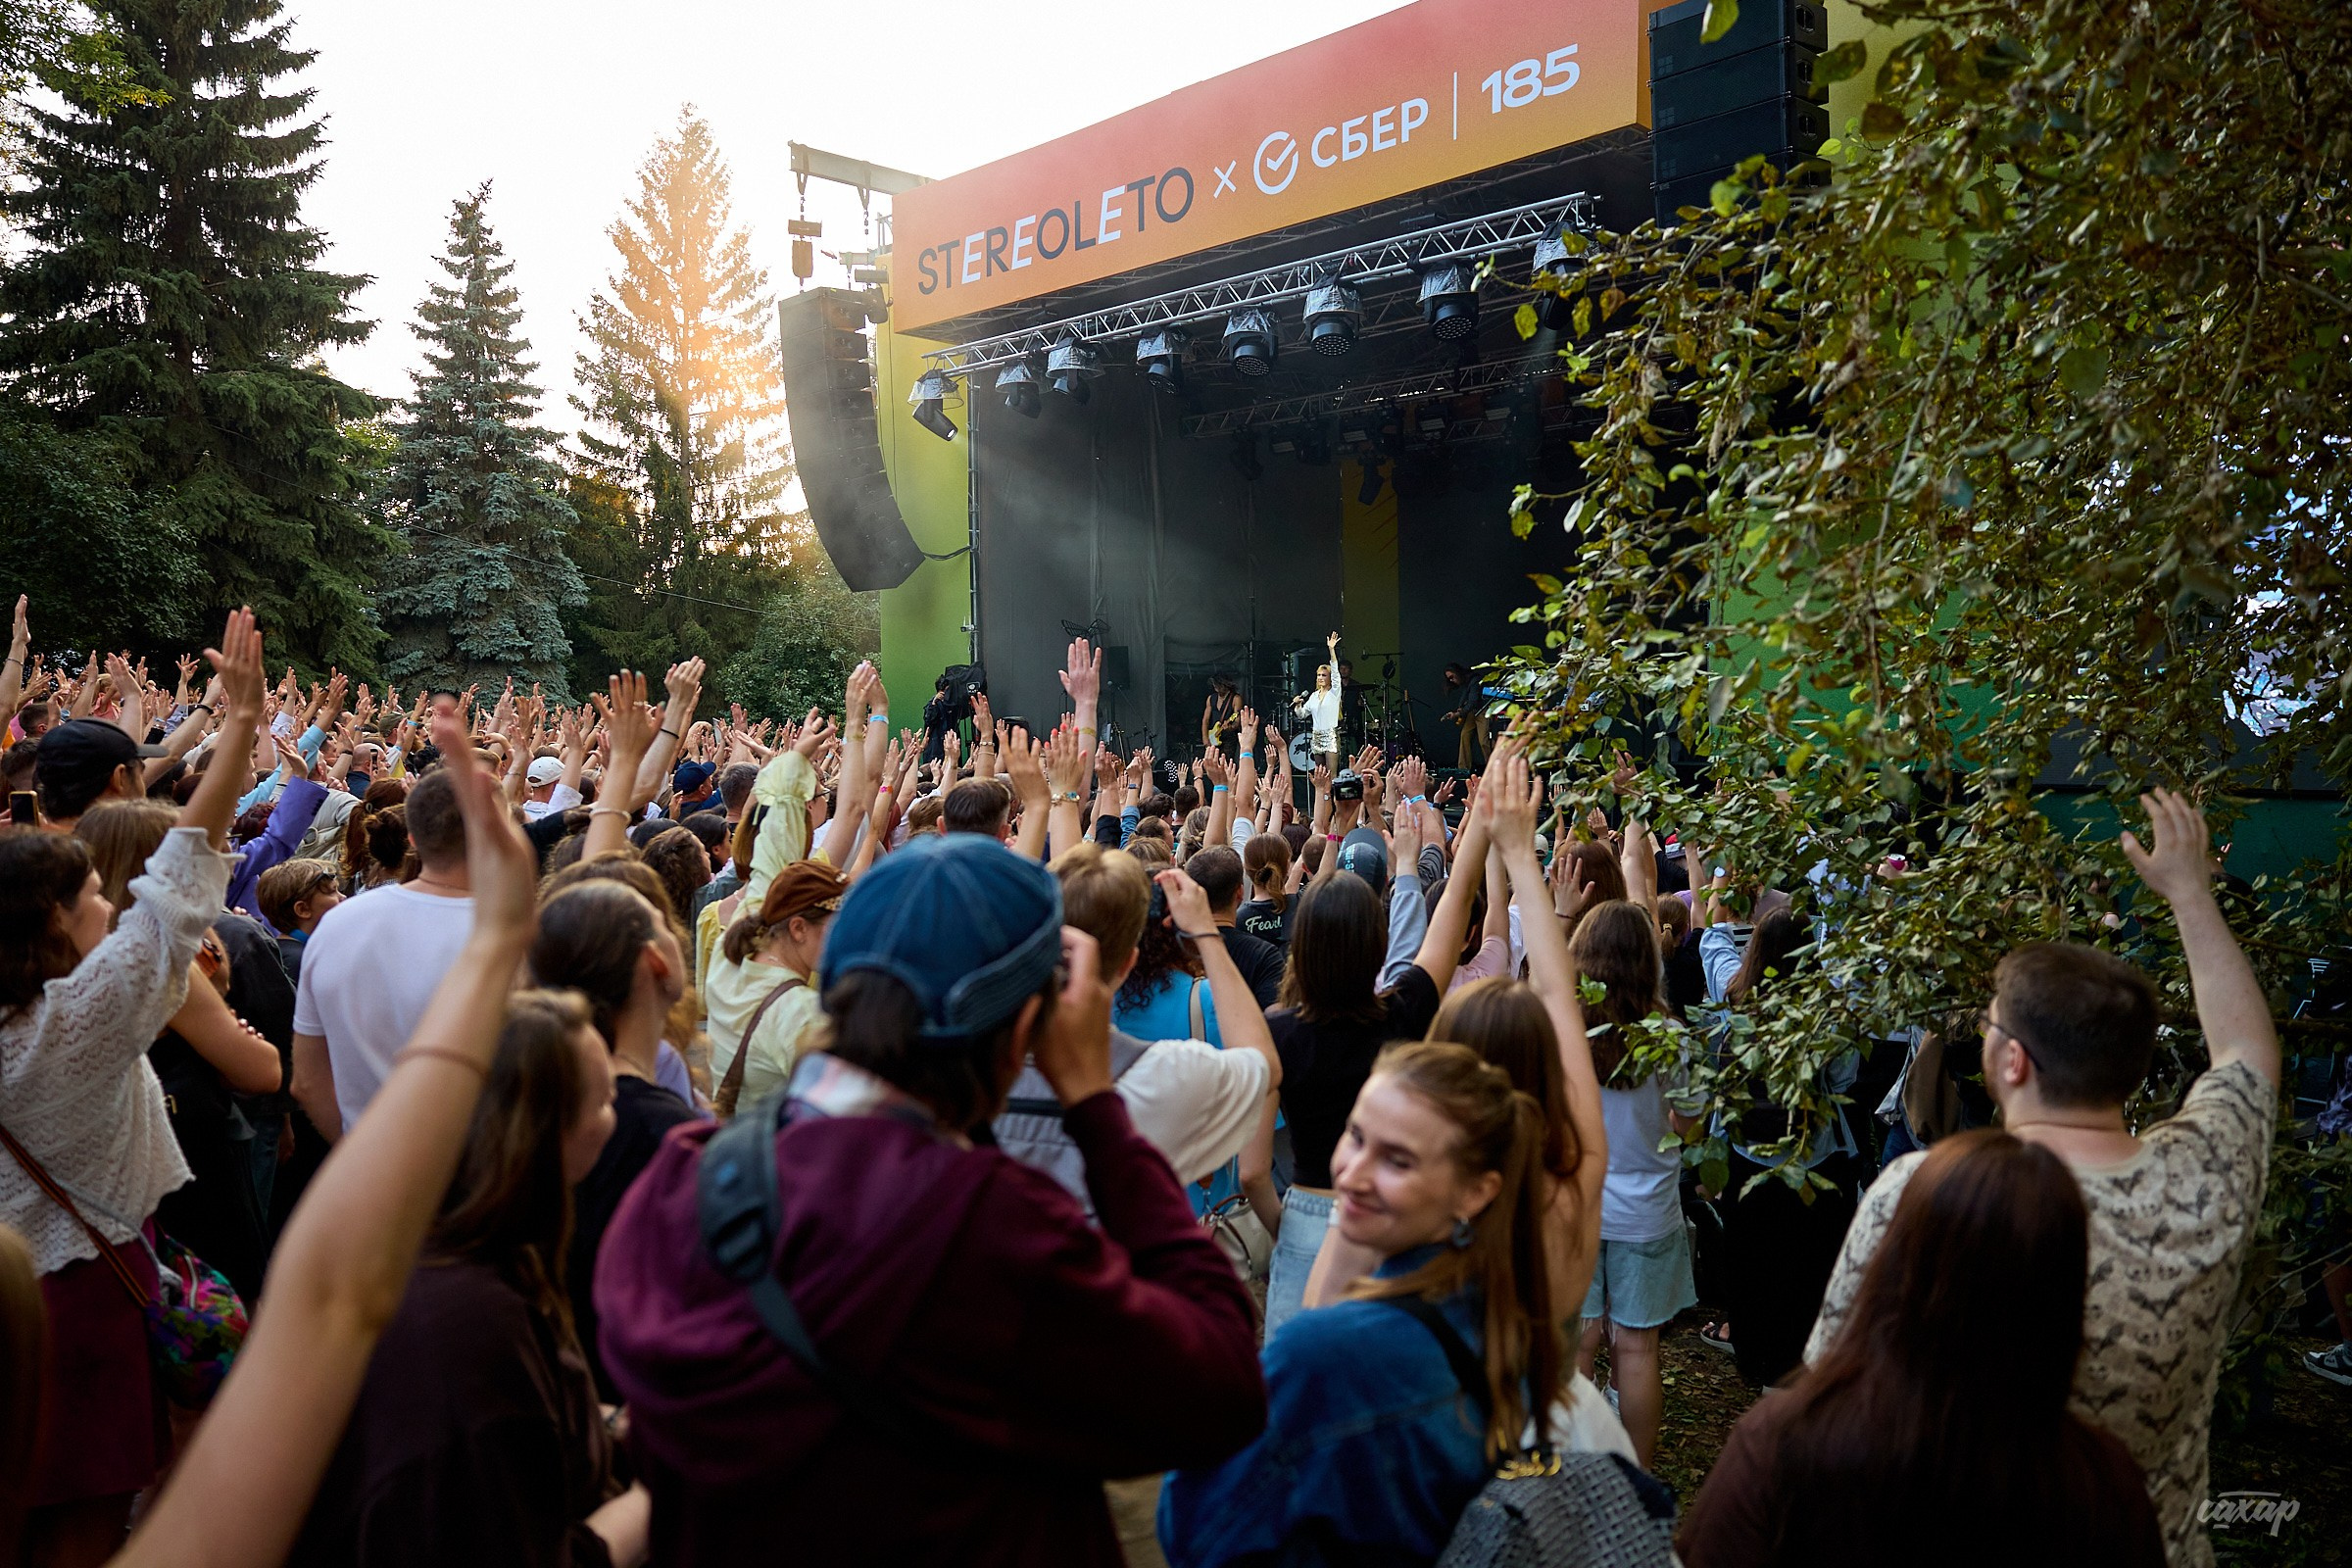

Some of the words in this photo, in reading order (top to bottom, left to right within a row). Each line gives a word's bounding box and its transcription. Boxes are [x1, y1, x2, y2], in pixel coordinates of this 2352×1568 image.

[918, 167, 1195, 295] STEREOLETO
[1311, 97, 1428, 169] СБЕР
[1481, 43, 1580, 115] 185
